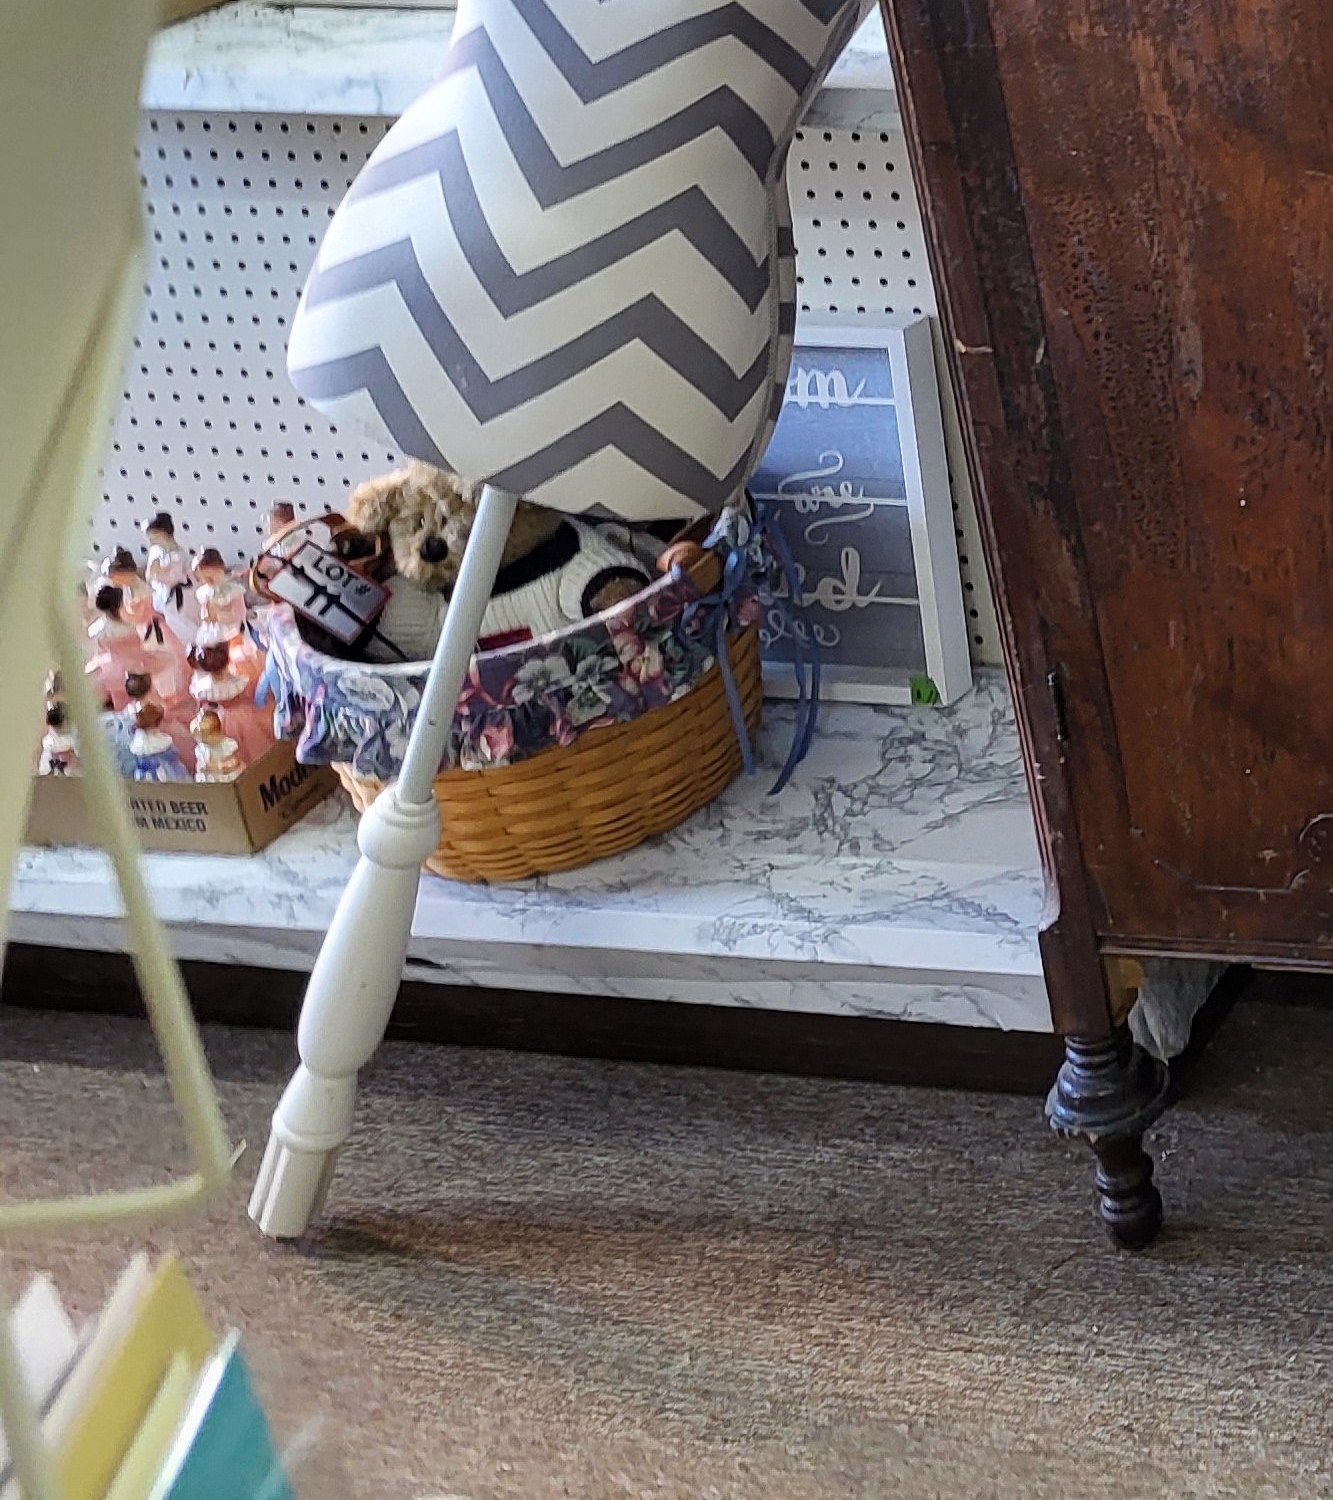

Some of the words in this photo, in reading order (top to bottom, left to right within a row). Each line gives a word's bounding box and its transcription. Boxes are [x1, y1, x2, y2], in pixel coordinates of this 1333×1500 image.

[312, 556, 359, 588] LOT
[170, 800, 208, 816] BEER
[153, 816, 207, 832] MEXICO
